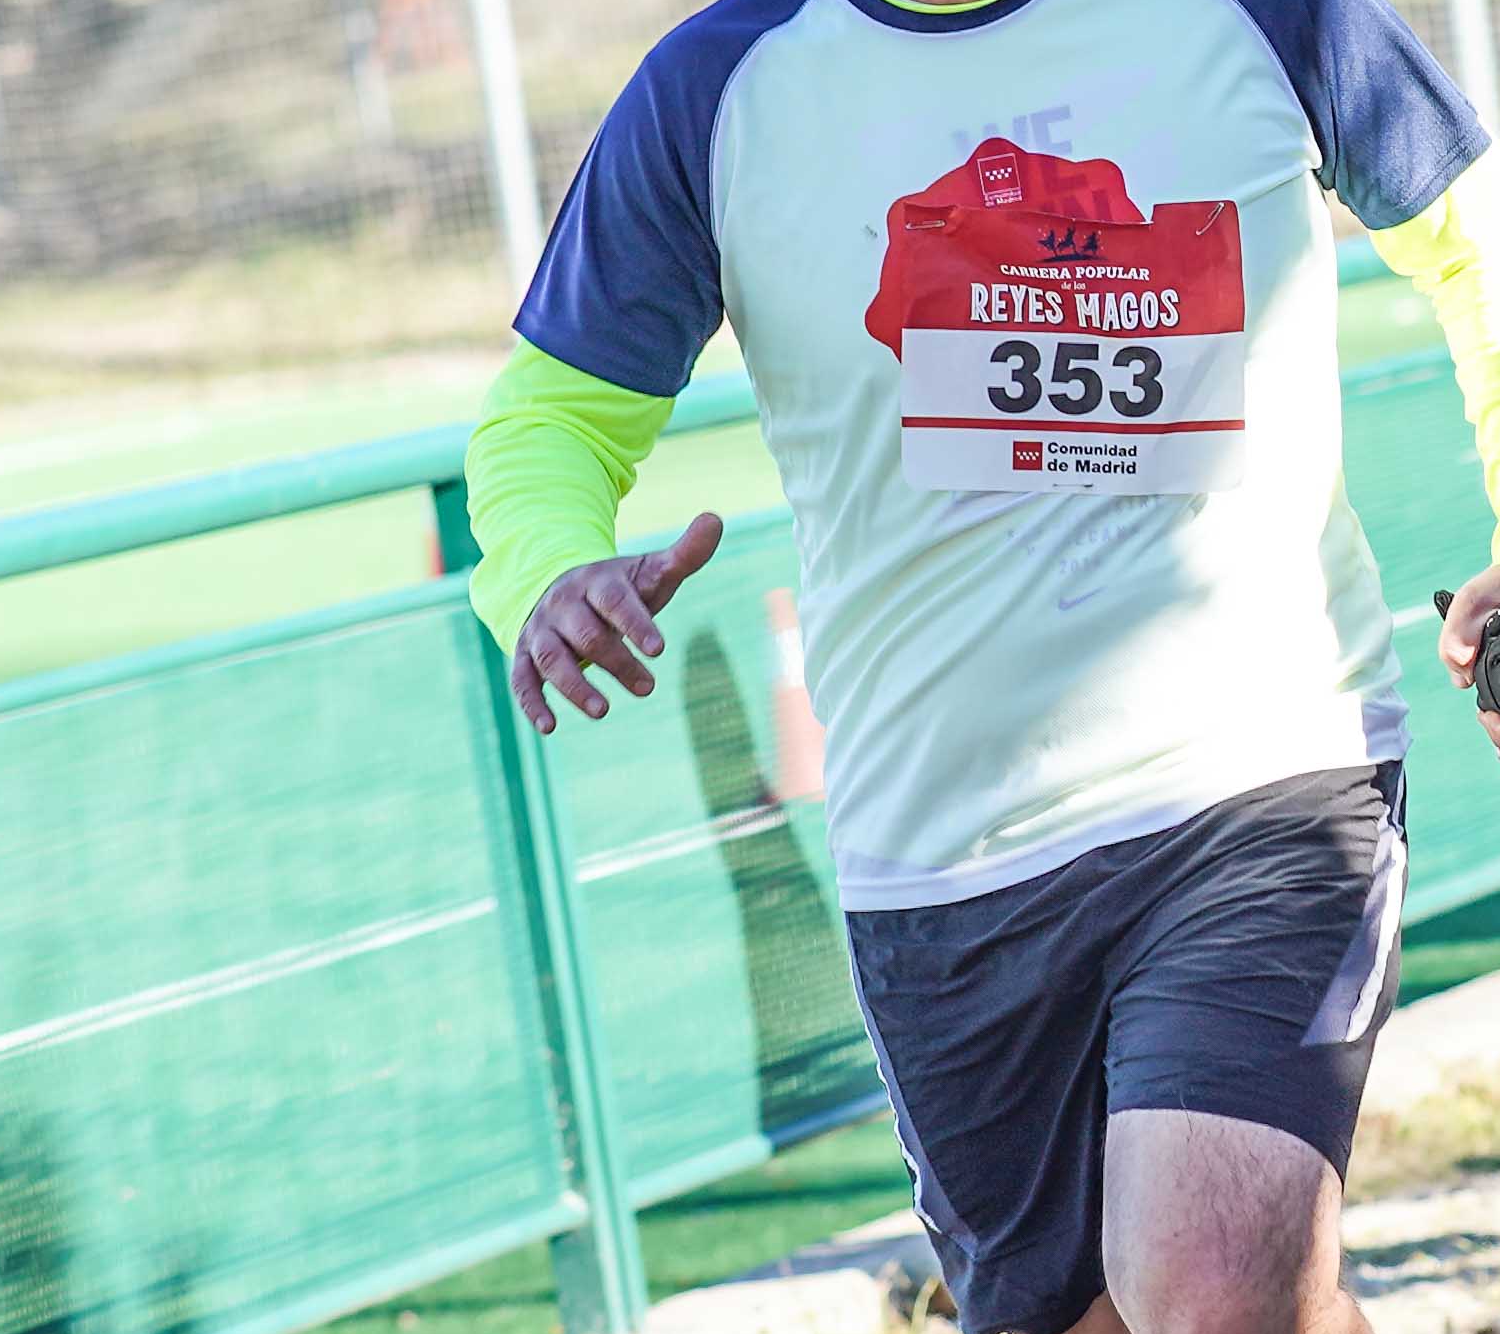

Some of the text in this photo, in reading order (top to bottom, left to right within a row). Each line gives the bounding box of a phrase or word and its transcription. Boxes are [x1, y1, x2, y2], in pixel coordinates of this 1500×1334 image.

[1000, 264, 1150, 282] CARRERA POPULAR
[1060, 280, 1086, 291] de los
[970, 282, 1180, 332] REYES MAGOS
[987, 340, 1164, 418] 353
[1047, 442, 1137, 457] Comunidad
[1047, 459, 1137, 474] de Madrid
